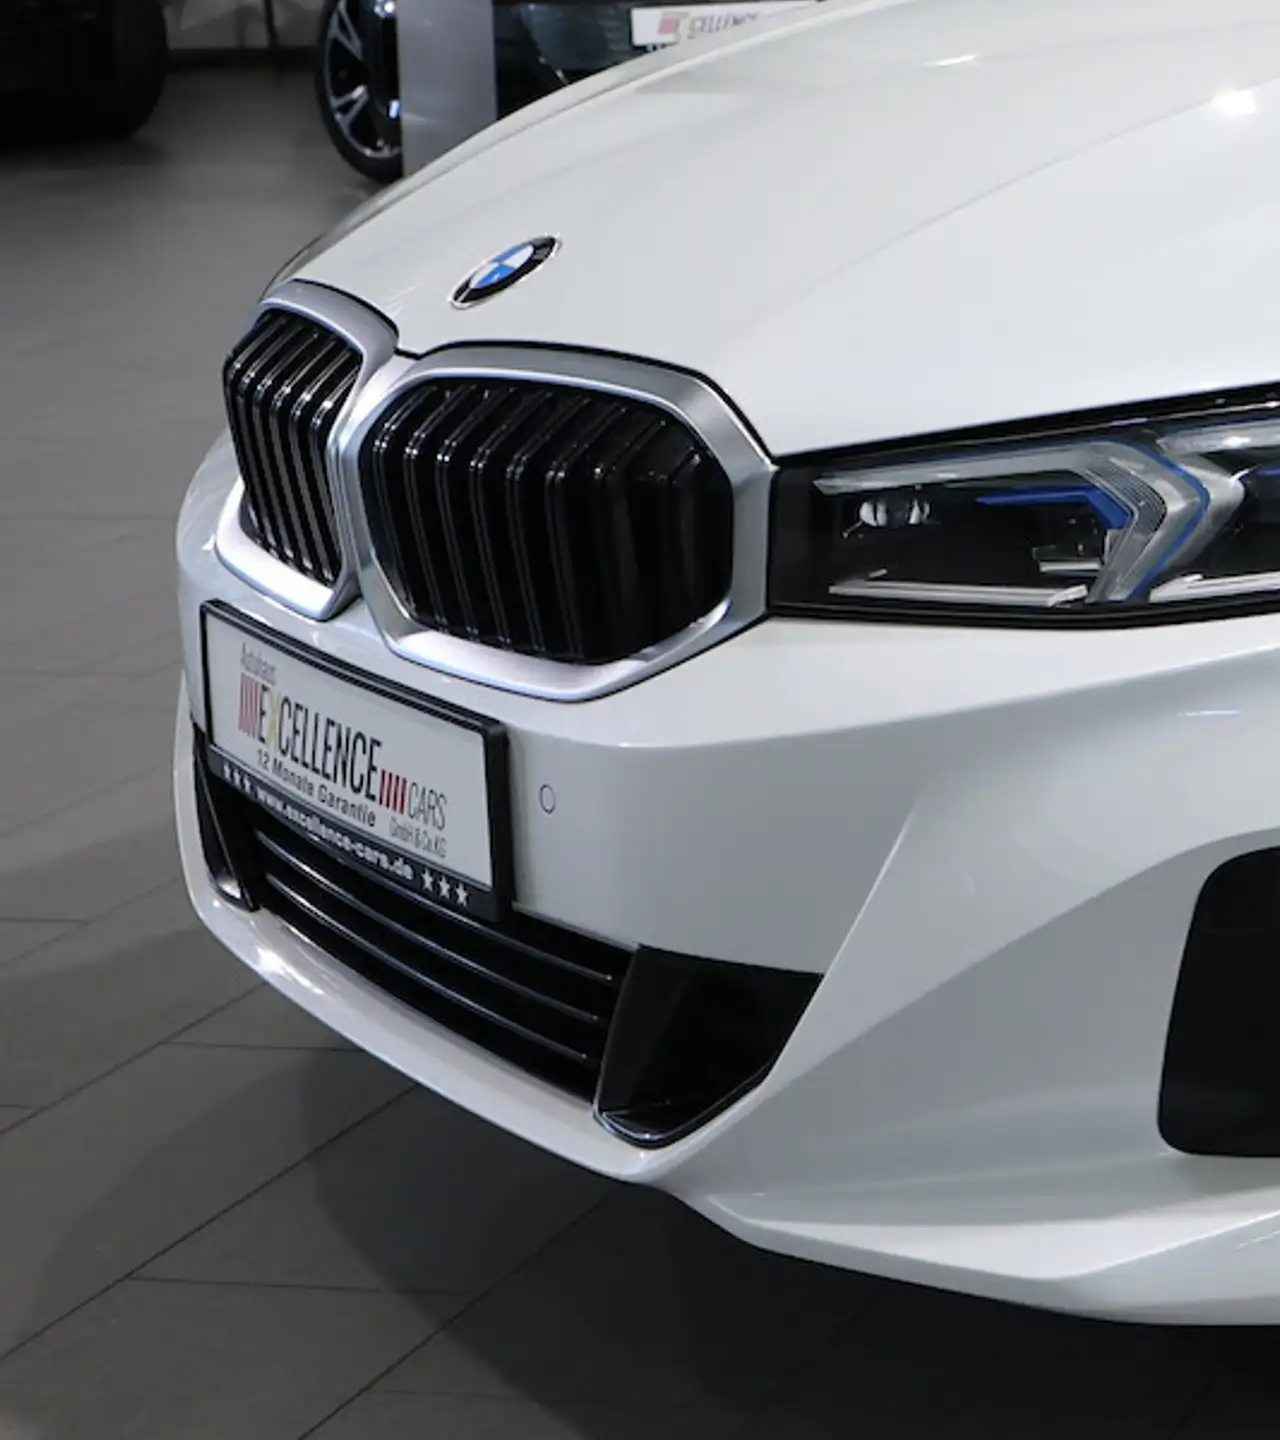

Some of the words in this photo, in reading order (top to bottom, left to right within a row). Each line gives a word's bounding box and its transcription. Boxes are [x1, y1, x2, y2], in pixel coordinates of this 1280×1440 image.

[258, 682, 382, 802] EXCELLENCE
[407, 781, 447, 831] CARS
[317, 783, 376, 828] Garantie
